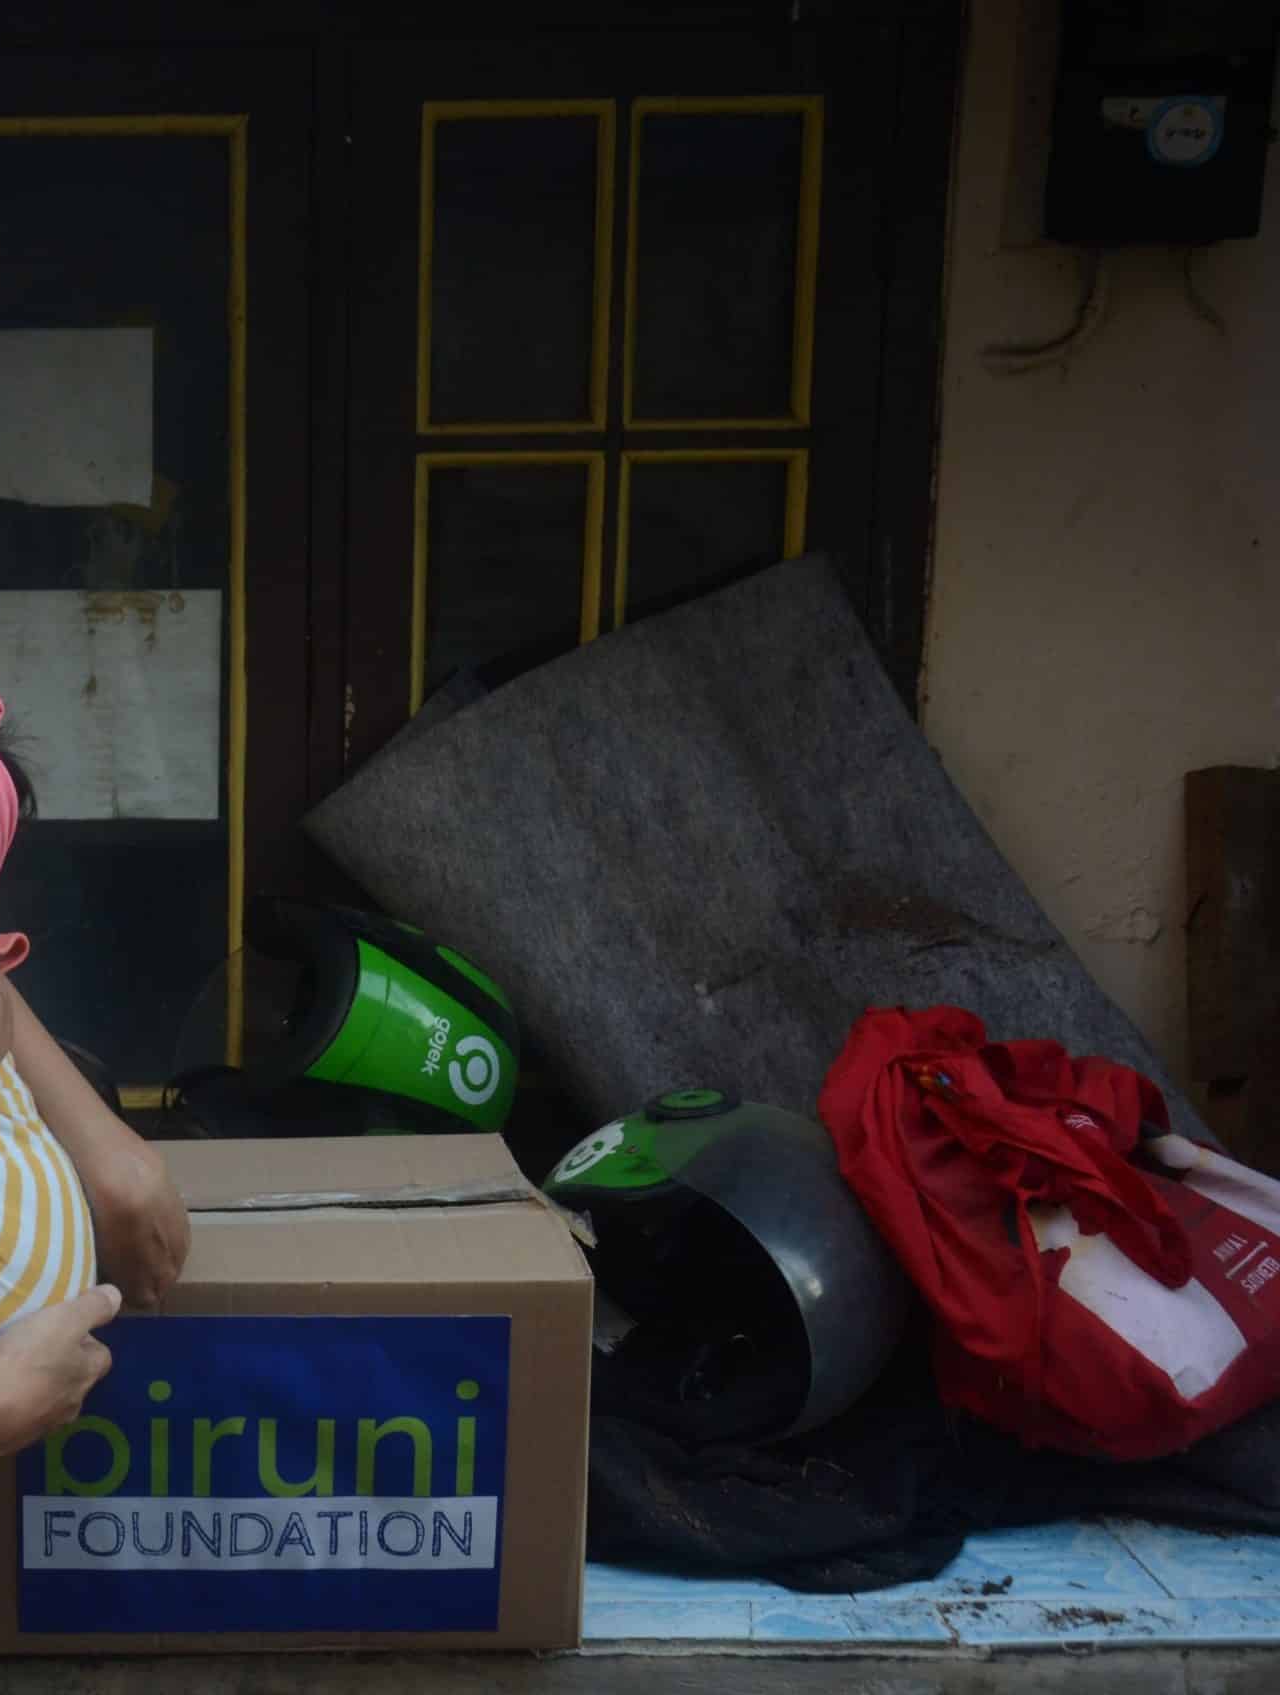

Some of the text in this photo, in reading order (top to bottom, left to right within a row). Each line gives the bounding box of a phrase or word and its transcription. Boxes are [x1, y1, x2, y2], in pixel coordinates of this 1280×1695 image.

[422, 1016, 450, 1075] gojek
[43, 1380, 480, 1498] biruni
[42, 1511, 472, 1557] FOUNDATION
